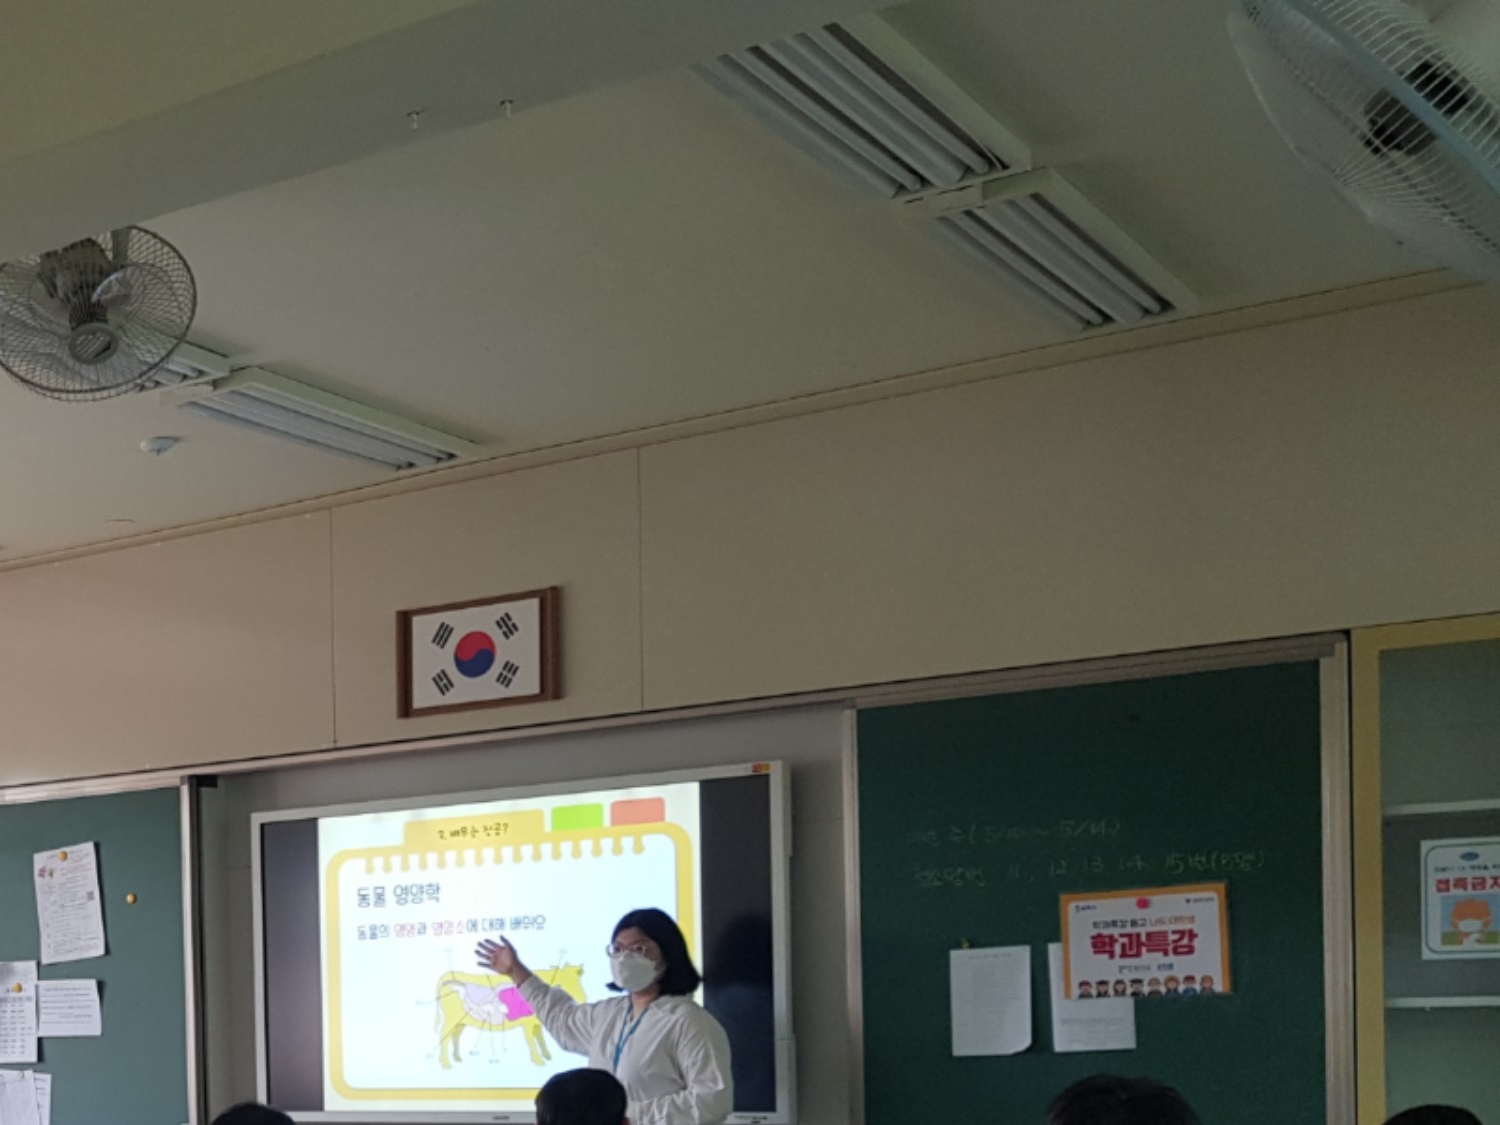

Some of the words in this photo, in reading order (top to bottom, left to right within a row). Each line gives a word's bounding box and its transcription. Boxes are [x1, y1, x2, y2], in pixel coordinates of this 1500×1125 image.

[357, 886, 386, 908] 동물
[393, 882, 440, 906] 영양학
[357, 924, 390, 940] 동물의
[431, 918, 479, 937] 영양소에
[481, 917, 506, 932] 대해
[509, 914, 546, 931] 배워요
[1090, 928, 1199, 961] 학과특강
